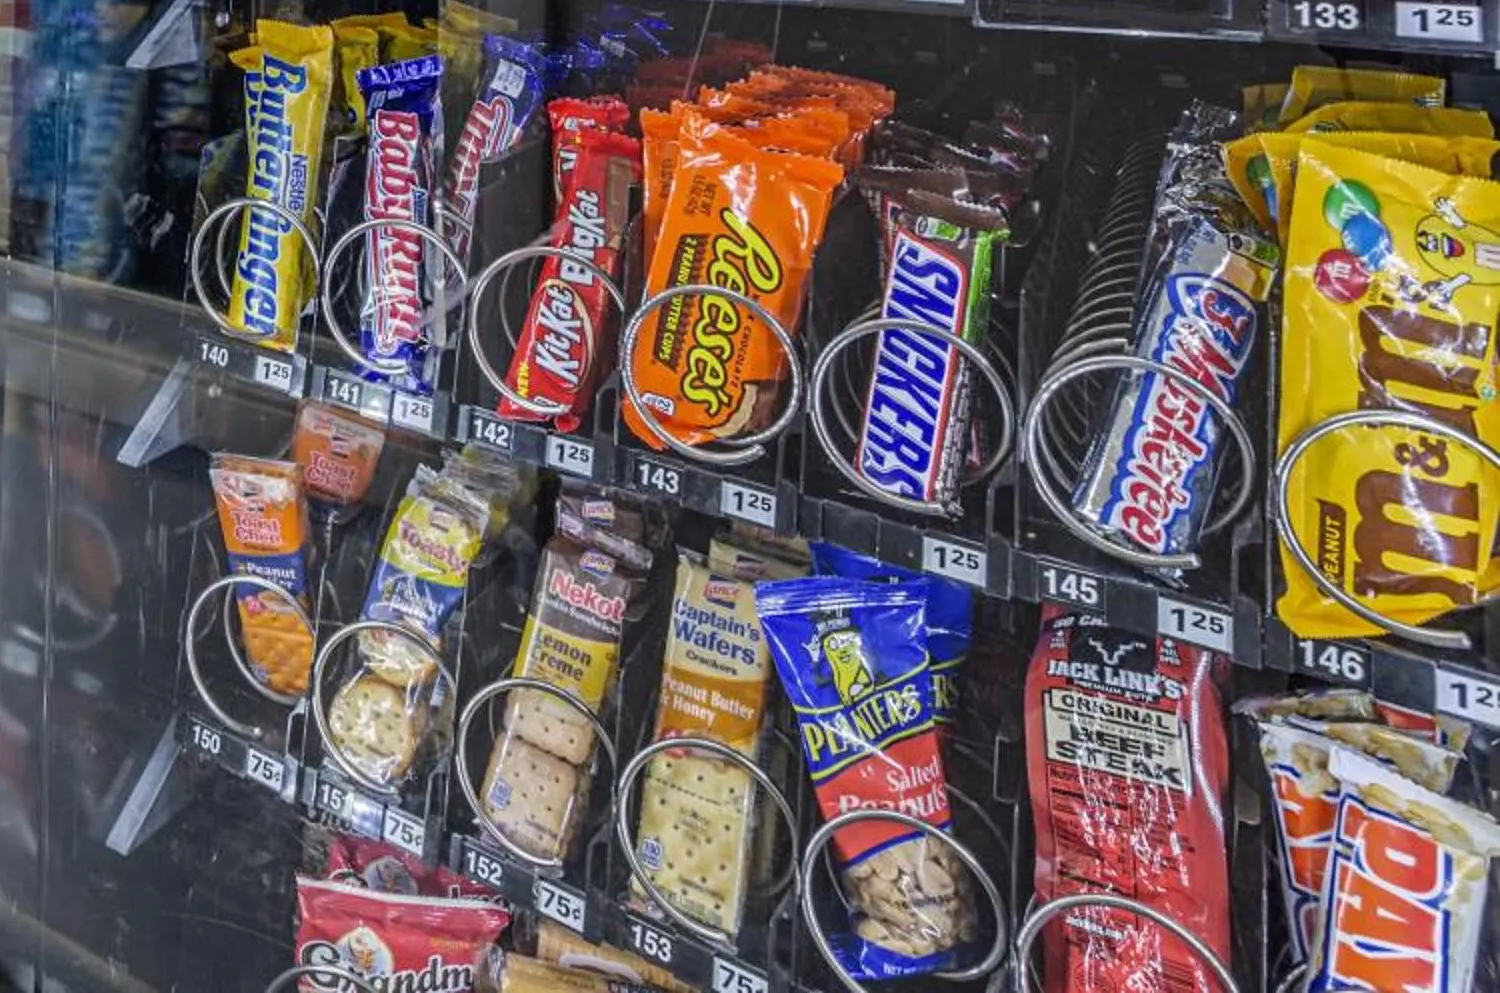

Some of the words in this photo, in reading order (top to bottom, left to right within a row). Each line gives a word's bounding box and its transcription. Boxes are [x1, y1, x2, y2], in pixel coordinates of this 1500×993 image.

[1294, 2, 1360, 30] 133
[365, 109, 421, 221] Baby
[234, 52, 309, 337] Butterfinger
[679, 206, 784, 417] Reese's
[1200, 288, 1250, 345] 3
[200, 343, 230, 366] 140
[860, 237, 962, 501] SNICKERS
[328, 379, 360, 403] 141
[472, 418, 510, 447] 142
[638, 462, 681, 493] 143
[1321, 515, 1346, 590] PEANUT
[550, 568, 627, 624] Nekot
[1043, 569, 1099, 602] 145
[674, 597, 761, 643] Captain's
[673, 619, 756, 666] Wafers
[1298, 639, 1366, 682] 146
[685, 649, 739, 677] Crackers
[1047, 659, 1100, 682] JACK
[662, 671, 708, 704] Peanut
[710, 689, 756, 720] Butter
[673, 694, 717, 727] Honey
[1061, 693, 1171, 730] ORIGINAL
[1448, 680, 1500, 710] 12
[192, 725, 221, 754] 150
[802, 683, 922, 762] PLANTERS
[1069, 723, 1166, 759] BEEF
[885, 754, 940, 793] Salted
[1055, 740, 1184, 787] STEAK
[467, 851, 503, 887] 152
[631, 924, 673, 963] 153
